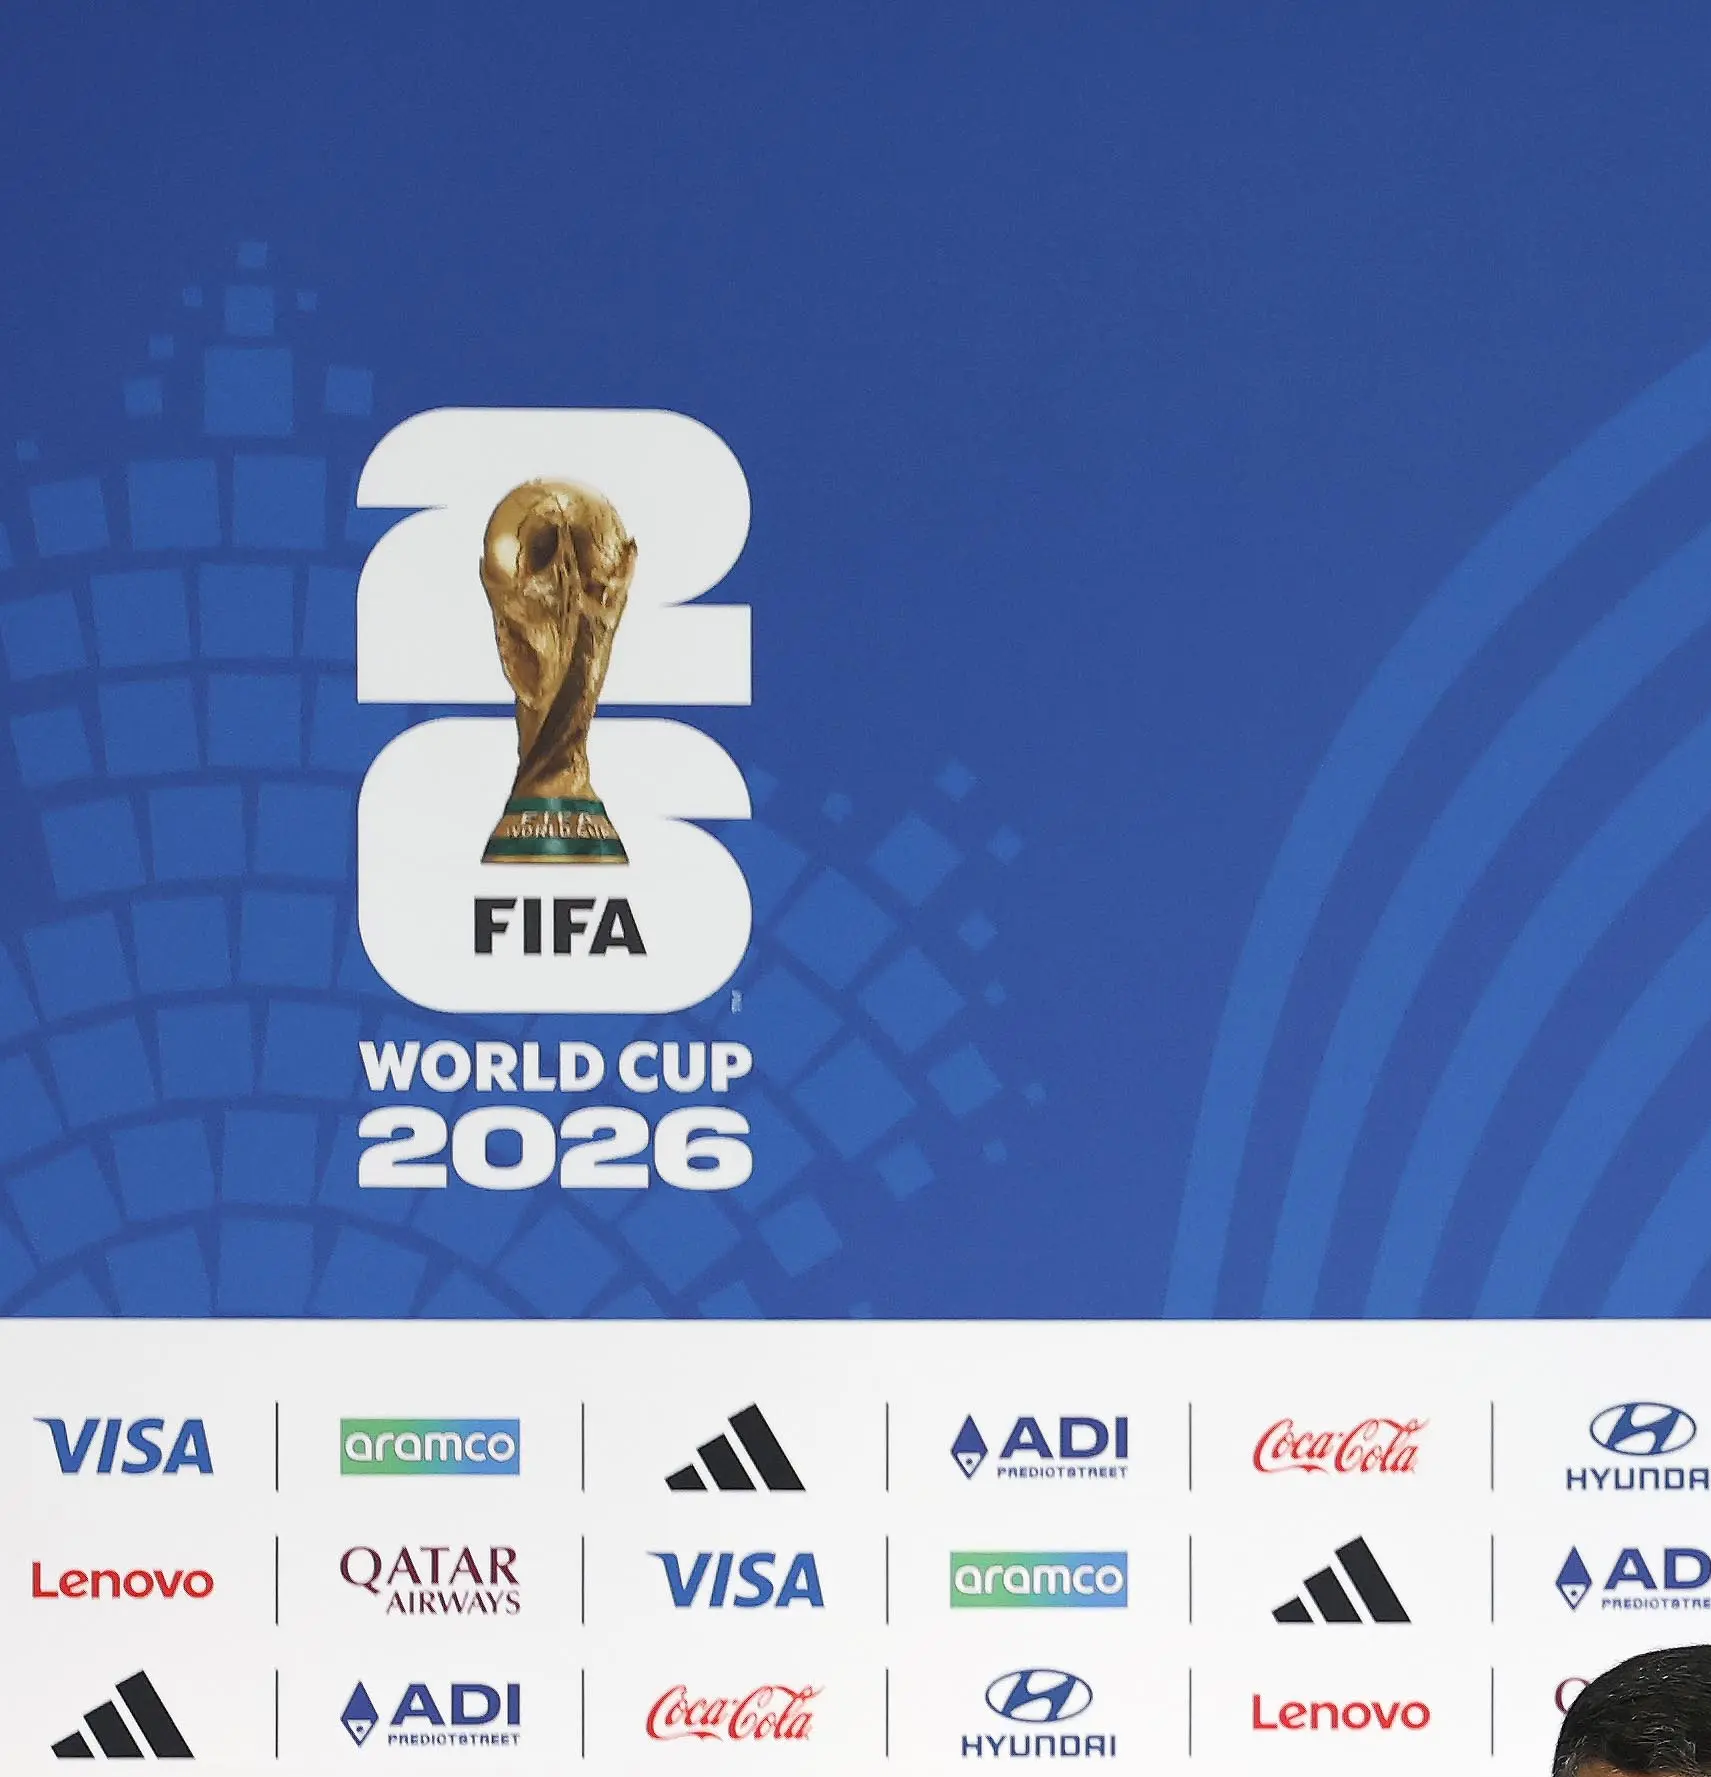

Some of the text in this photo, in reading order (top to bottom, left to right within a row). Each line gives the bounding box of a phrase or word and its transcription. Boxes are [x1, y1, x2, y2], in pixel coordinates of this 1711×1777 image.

[473, 897, 647, 957] FIFA
[358, 1040, 753, 1093] WORLD CUP
[358, 1105, 753, 1191] 2026
[32, 1416, 215, 1477] VISA
[345, 1432, 515, 1461] aramco
[998, 1415, 1129, 1460] ADI
[31, 1560, 215, 1600] Lenovo
[339, 1545, 518, 1593] QATAR
[385, 1590, 521, 1616] AIRWAYS
[961, 1734, 1116, 1758] HYUNDAI
